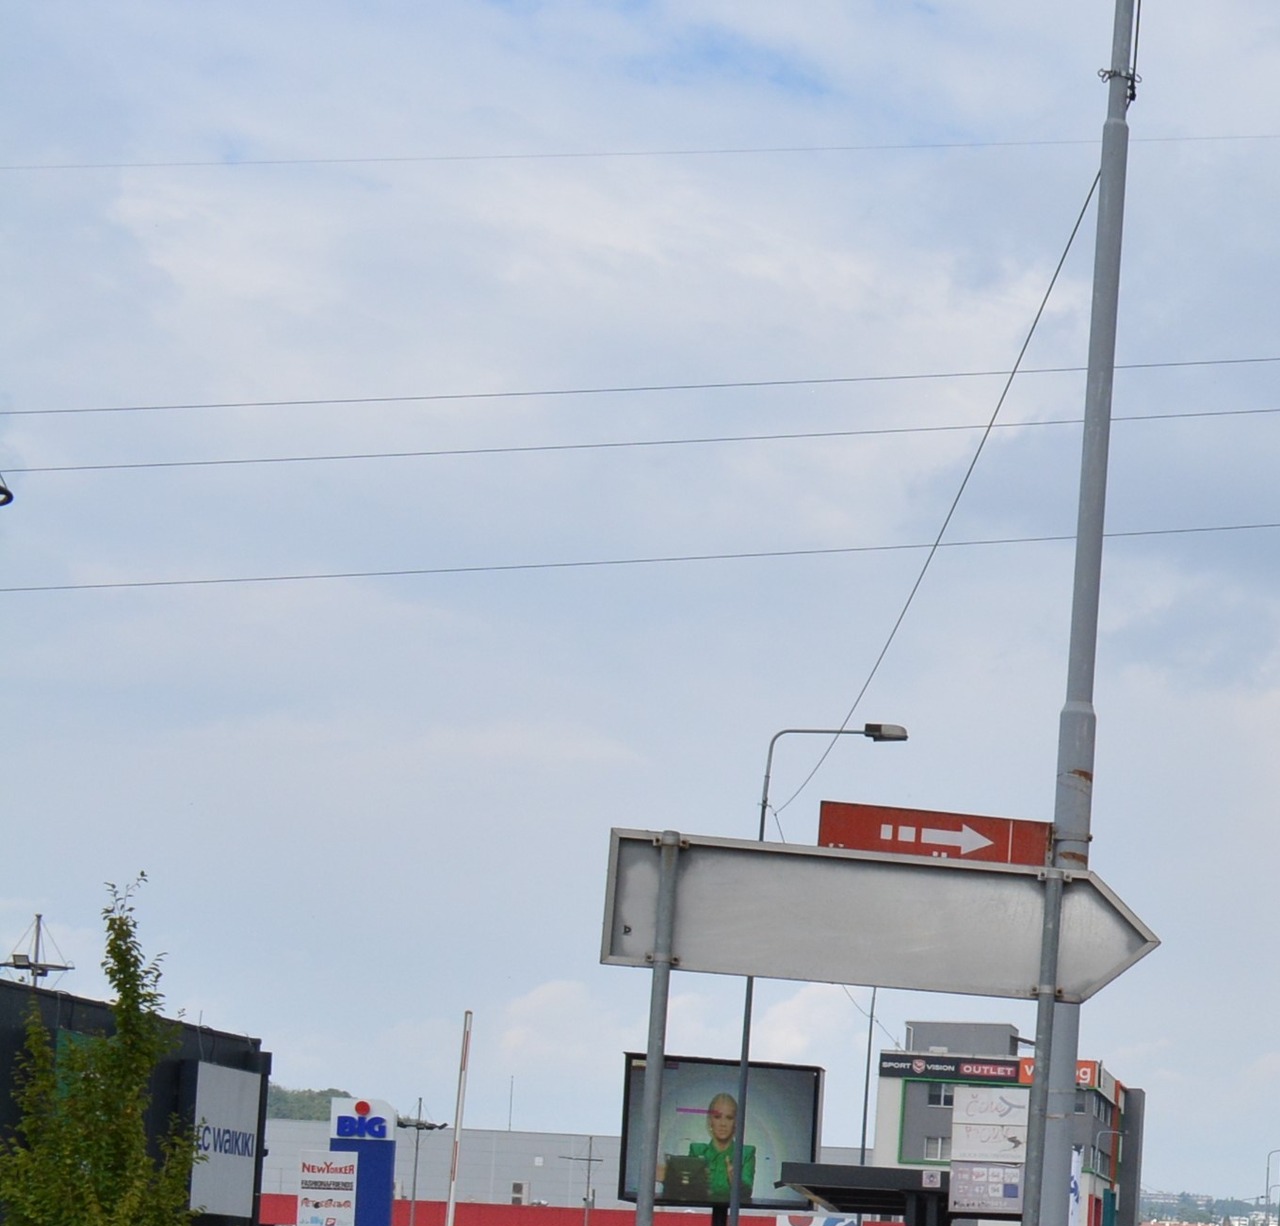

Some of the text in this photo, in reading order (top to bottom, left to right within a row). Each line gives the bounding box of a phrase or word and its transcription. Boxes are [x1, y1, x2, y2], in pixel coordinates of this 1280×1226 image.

[881, 1061, 911, 1069] SPORT
[926, 1063, 955, 1072] VISION
[962, 1065, 1014, 1076] OUTLET
